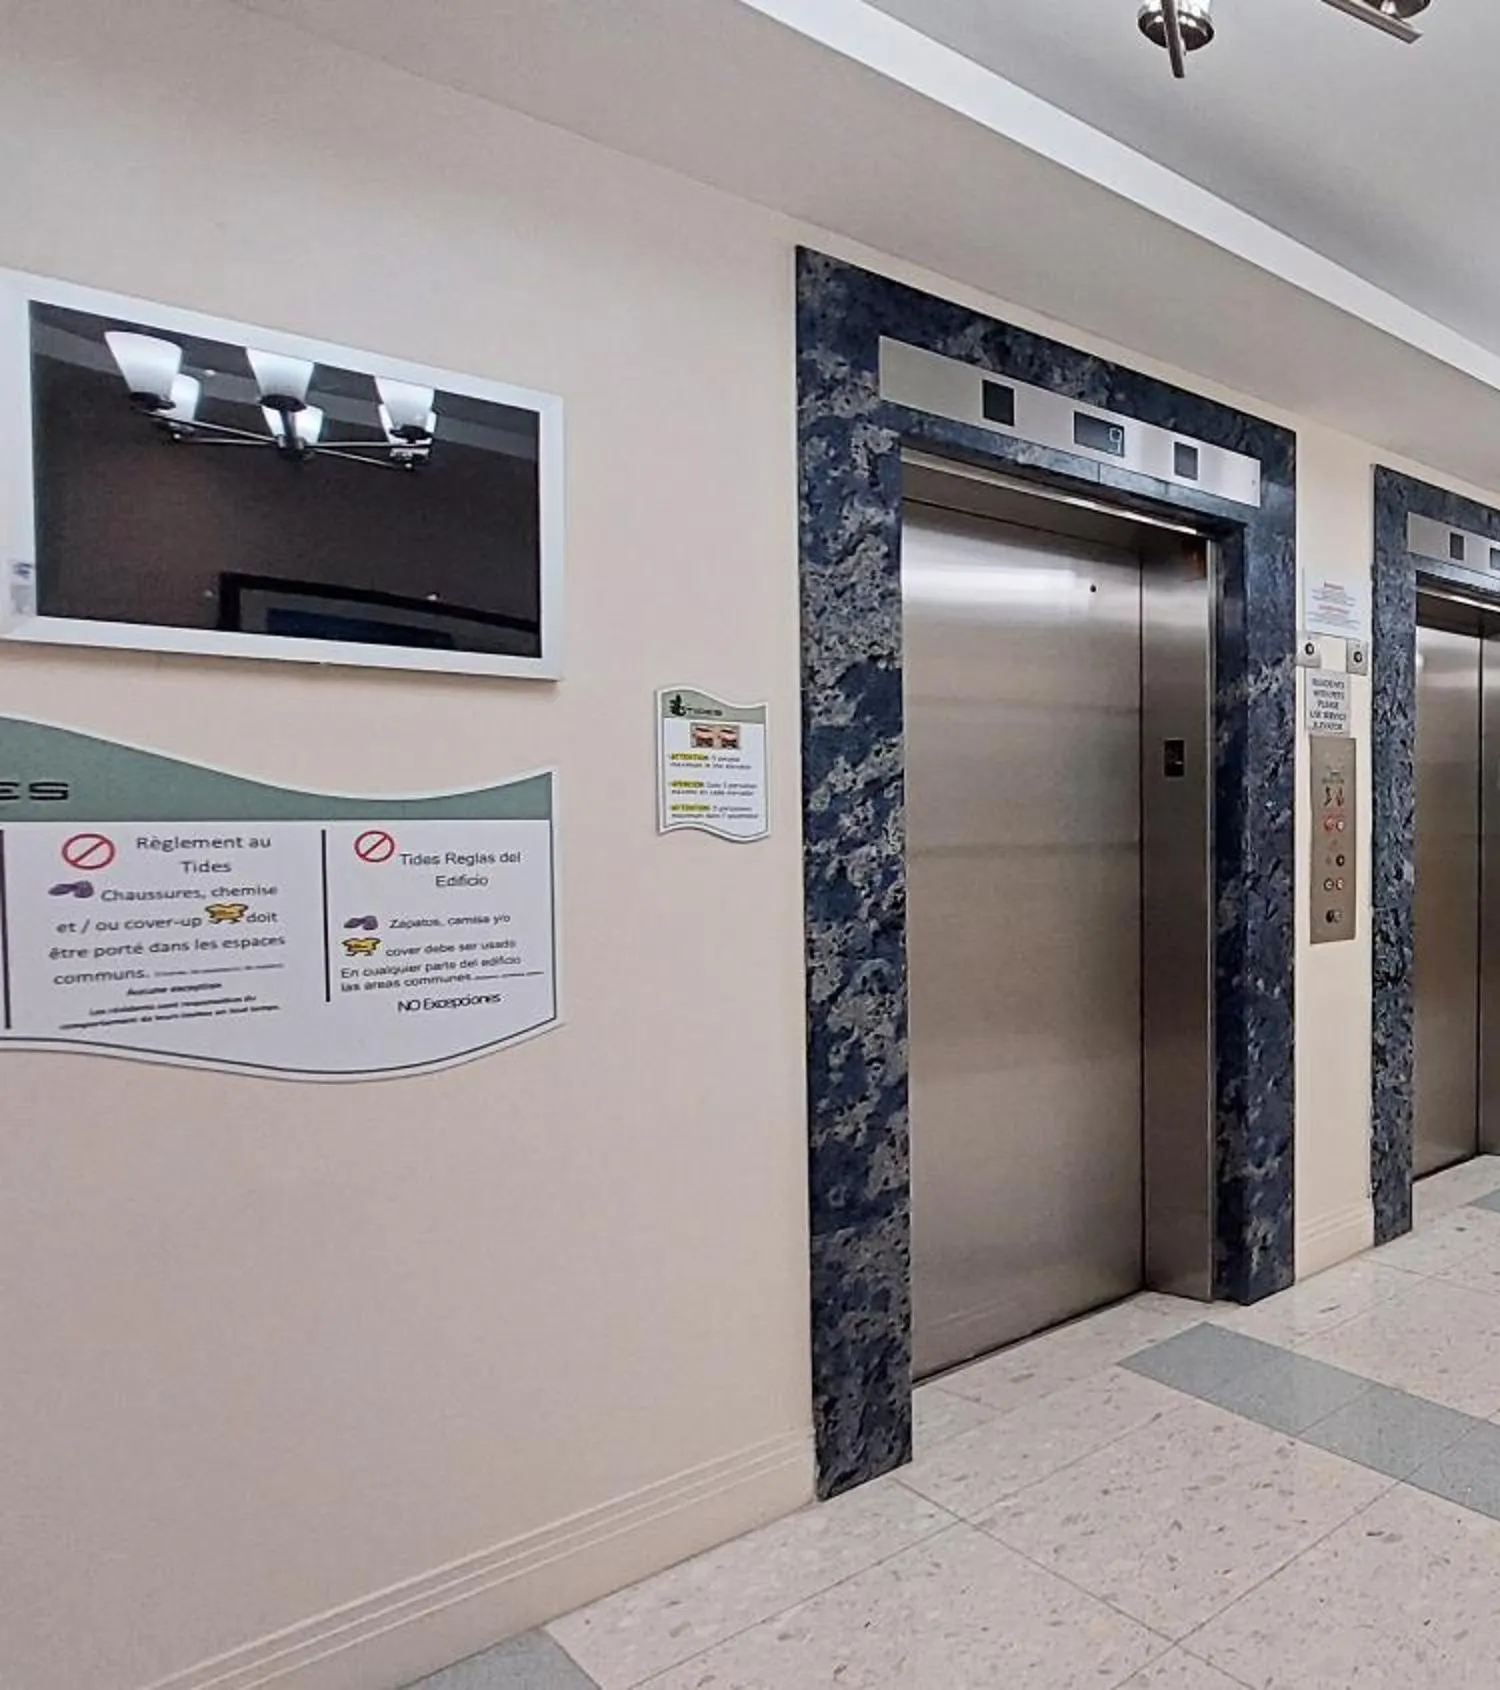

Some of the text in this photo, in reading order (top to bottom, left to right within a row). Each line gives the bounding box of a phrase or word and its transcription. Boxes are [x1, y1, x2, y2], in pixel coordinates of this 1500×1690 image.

[136, 836, 272, 852] Règlement au
[181, 860, 232, 873] Tides
[400, 851, 521, 867] Tides Reglas del
[435, 874, 489, 888] Edificio
[101, 885, 278, 901] Chaussures, chemise
[56, 912, 278, 935] et / ou cover-up doit
[447, 915, 490, 926] camisa
[49, 935, 286, 960] être porté dans les espaces
[386, 939, 517, 957] cover debe ser usado
[341, 955, 522, 979] En cualquier parte del edificio
[341, 982, 361, 993] las
[398, 993, 502, 1013] NO Excepciones
